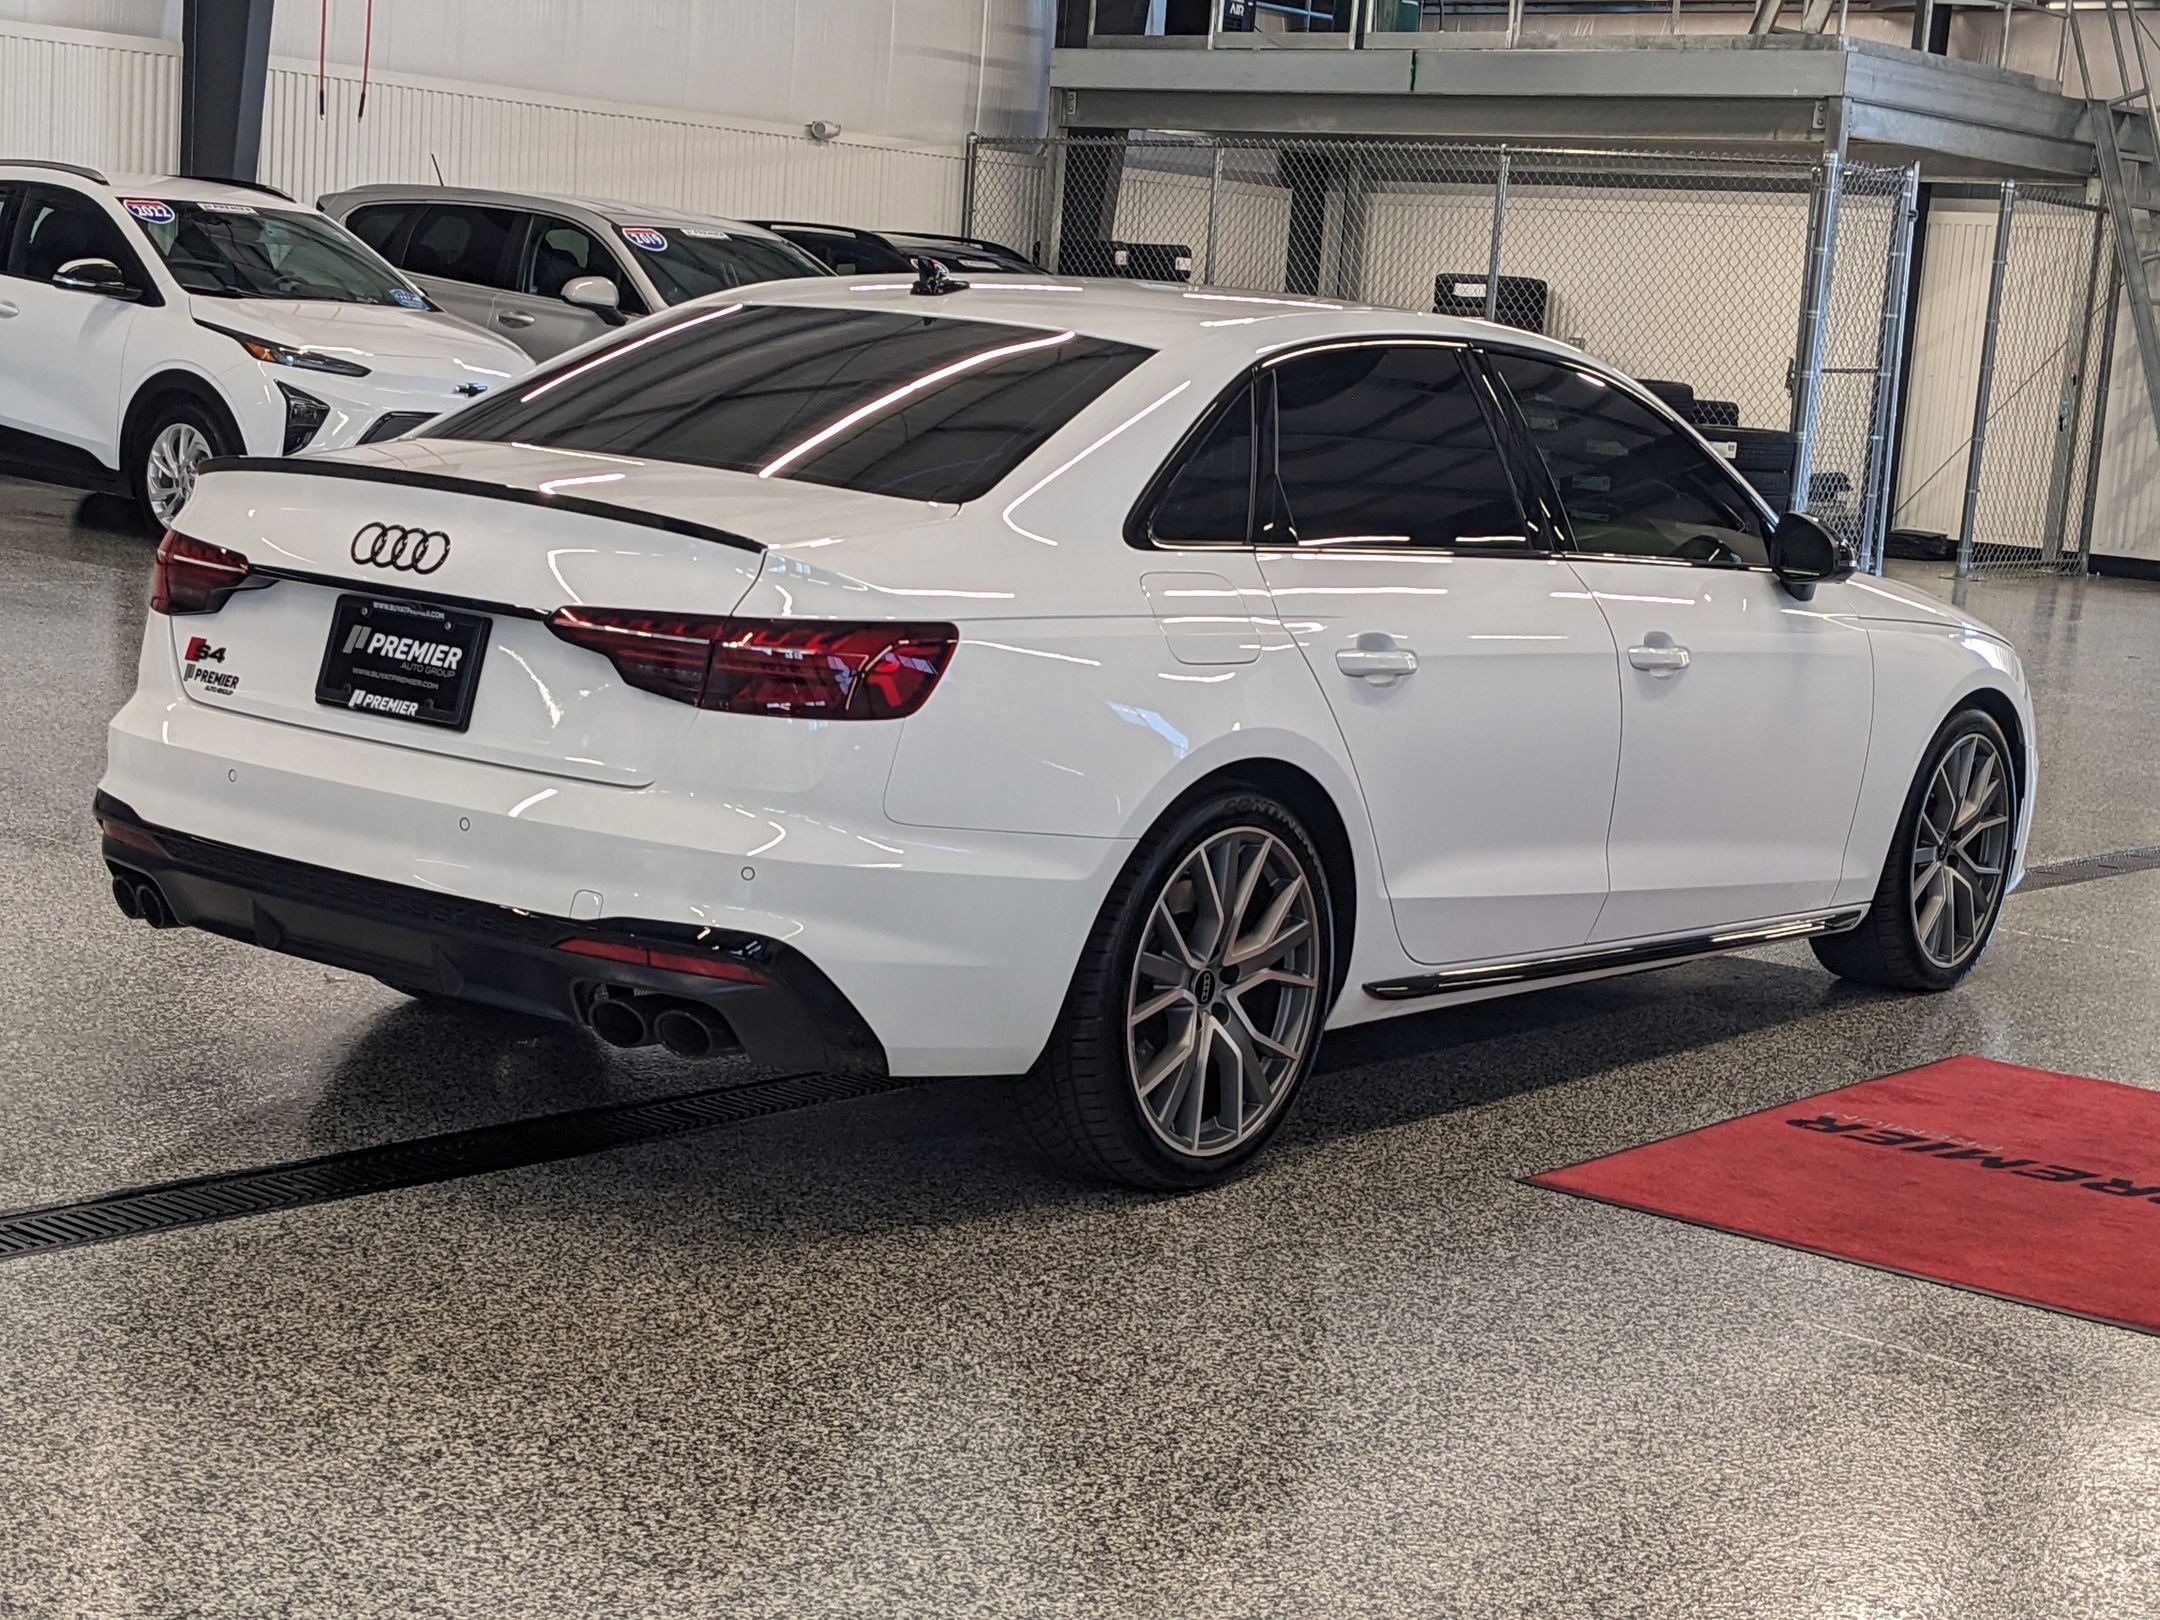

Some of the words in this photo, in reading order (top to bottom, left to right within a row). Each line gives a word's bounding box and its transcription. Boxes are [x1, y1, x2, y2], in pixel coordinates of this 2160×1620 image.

[132, 204, 172, 217] 2022
[630, 232, 663, 245] 2019
[195, 644, 227, 664] S4
[367, 632, 463, 670] PREMIER
[193, 667, 240, 690] PREMIER
[400, 661, 424, 673] AUTO
[424, 665, 456, 679] GROUP
[362, 694, 419, 717] PREMIER
[1786, 1115, 2160, 1205] REMIER
